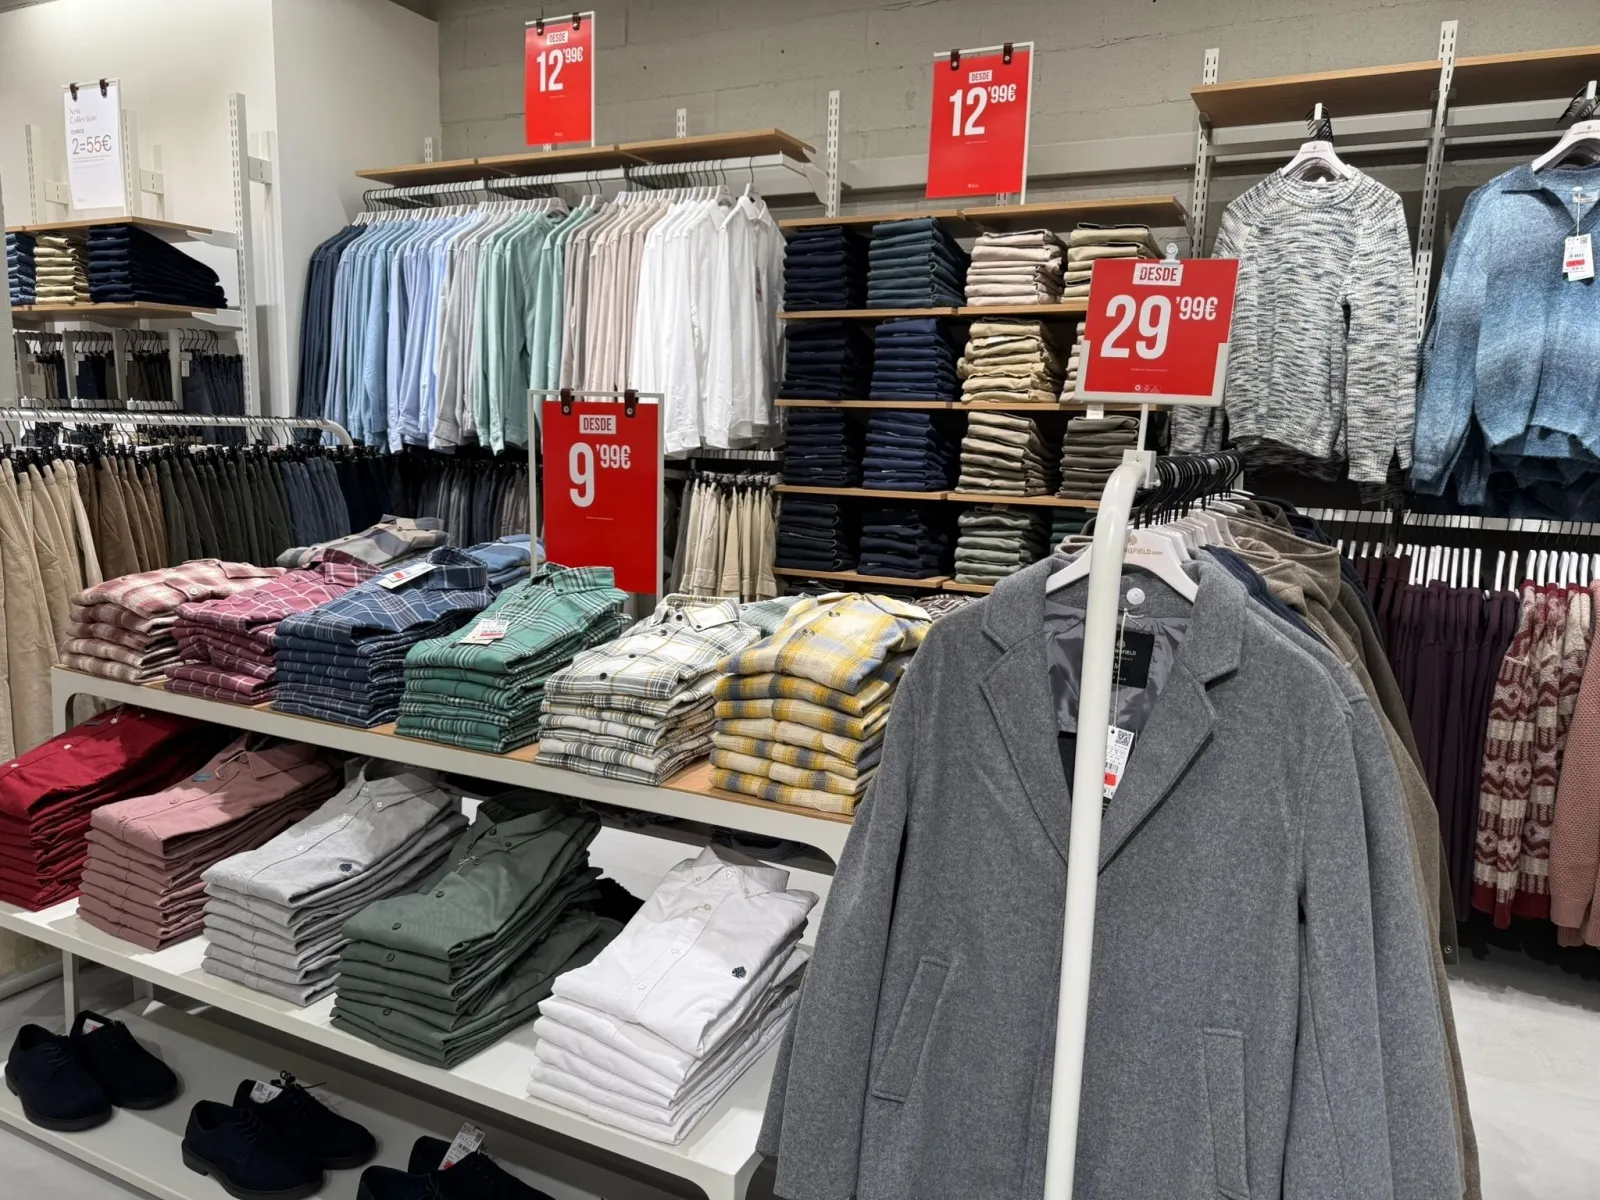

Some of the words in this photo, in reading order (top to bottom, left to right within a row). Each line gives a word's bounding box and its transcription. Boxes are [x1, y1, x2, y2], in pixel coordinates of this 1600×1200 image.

[548, 32, 567, 43] DESDE
[971, 71, 990, 82] DESDE
[72, 134, 112, 155] 2=55€
[1139, 266, 1179, 282] DESDE
[583, 417, 612, 431] DESDE
[1123, 547, 1163, 556] NGFIELD.com
